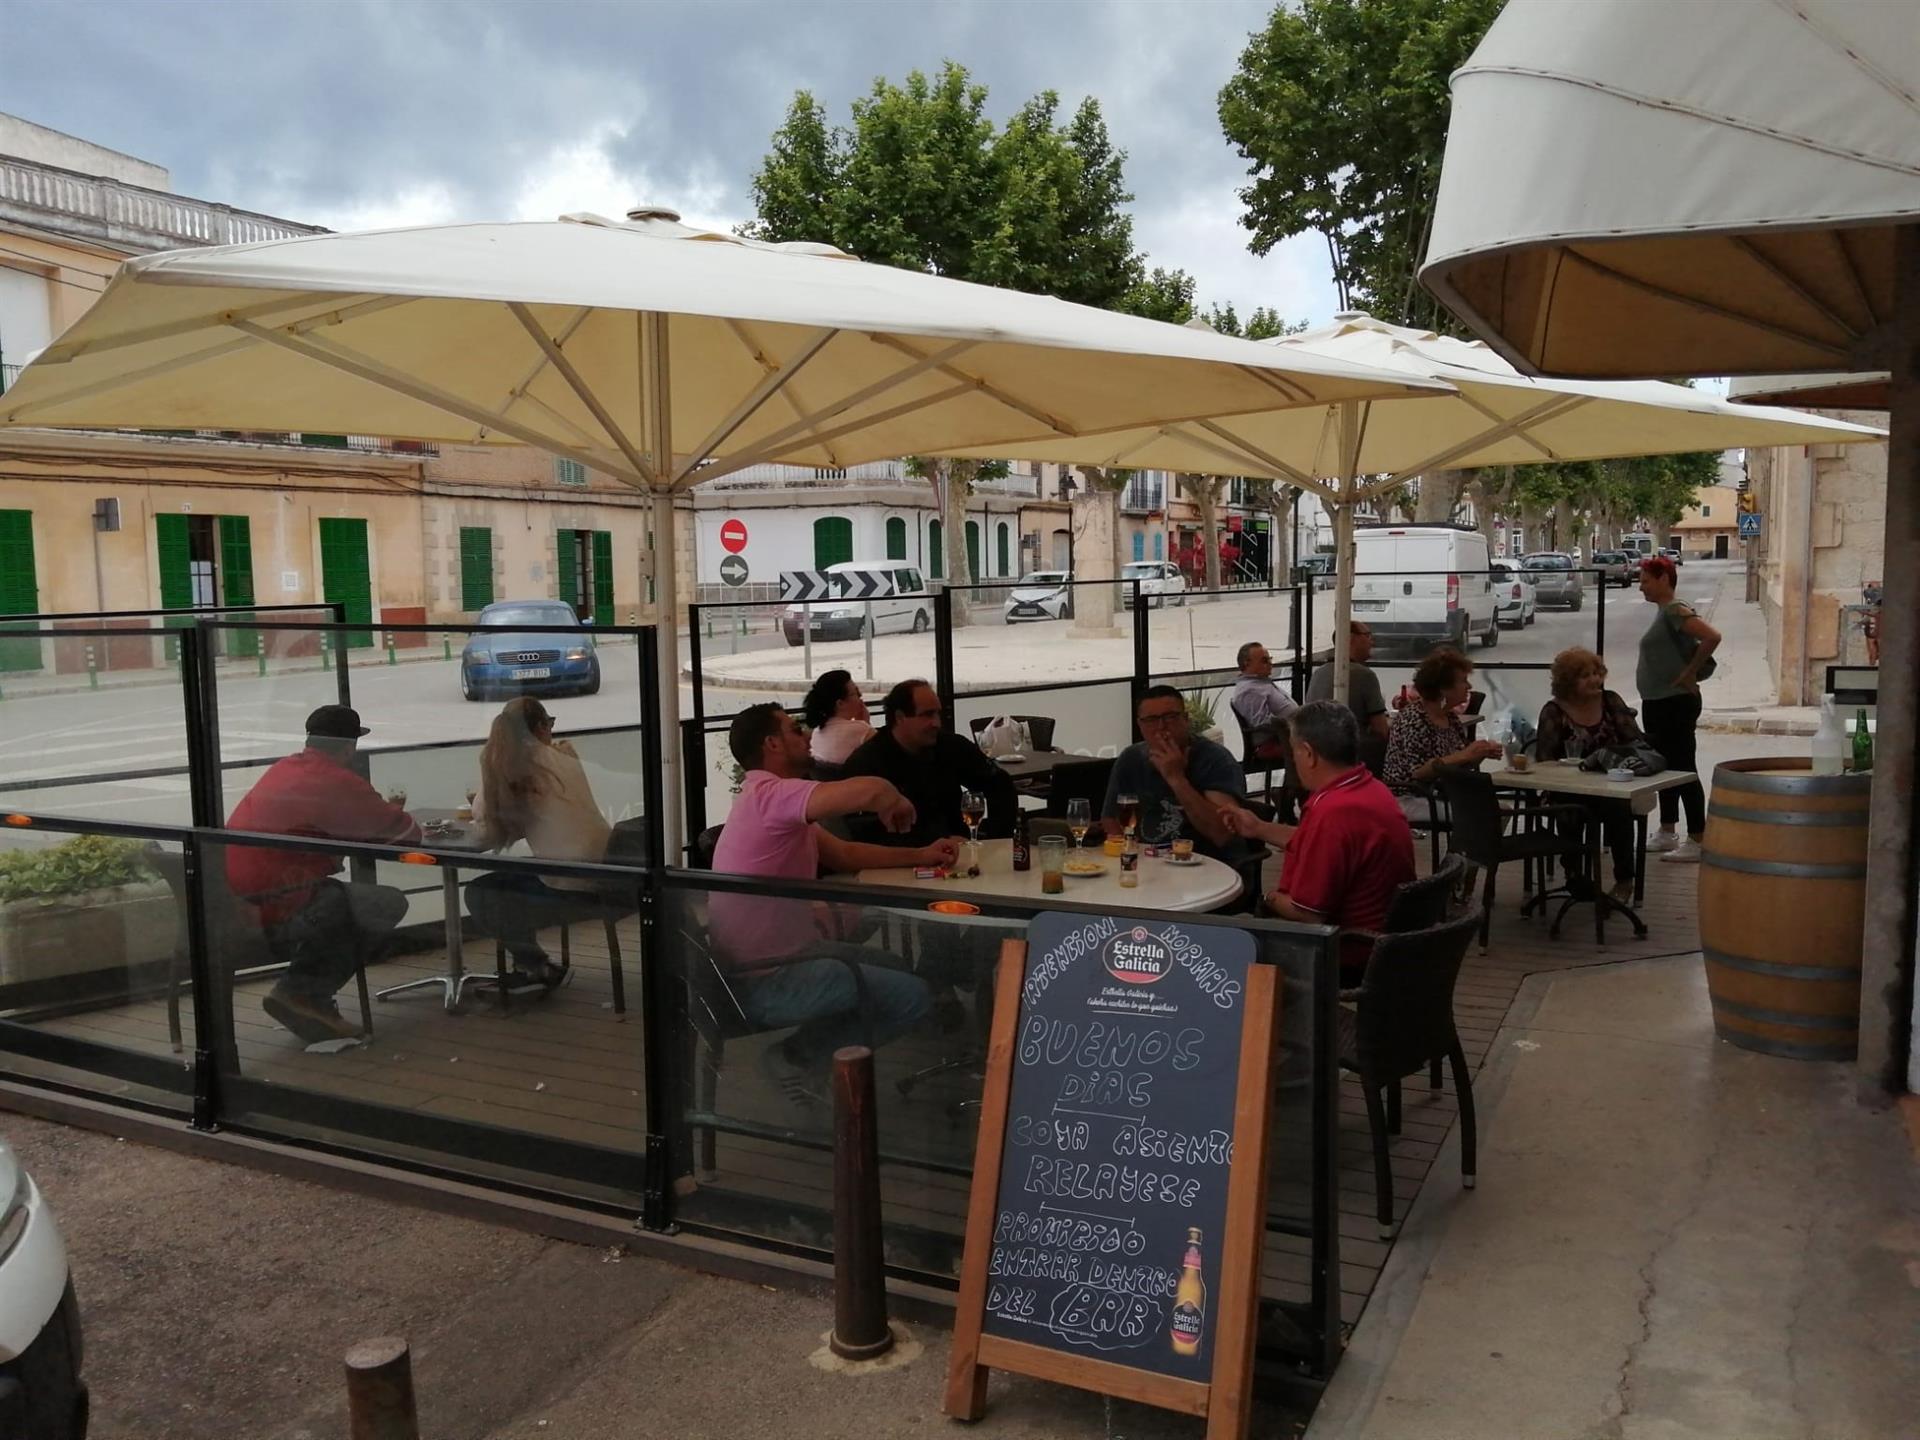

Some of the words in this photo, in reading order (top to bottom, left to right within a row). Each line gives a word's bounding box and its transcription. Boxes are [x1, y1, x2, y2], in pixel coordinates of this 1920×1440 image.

[1113, 940, 1164, 959] Estrella
[1114, 954, 1160, 973] Galicia
[1020, 1015, 1205, 1071] BUENOS
[988, 1247, 1081, 1283] ENTRAR
[986, 1283, 1037, 1316] DEL
[1060, 1286, 1149, 1338] BAR
